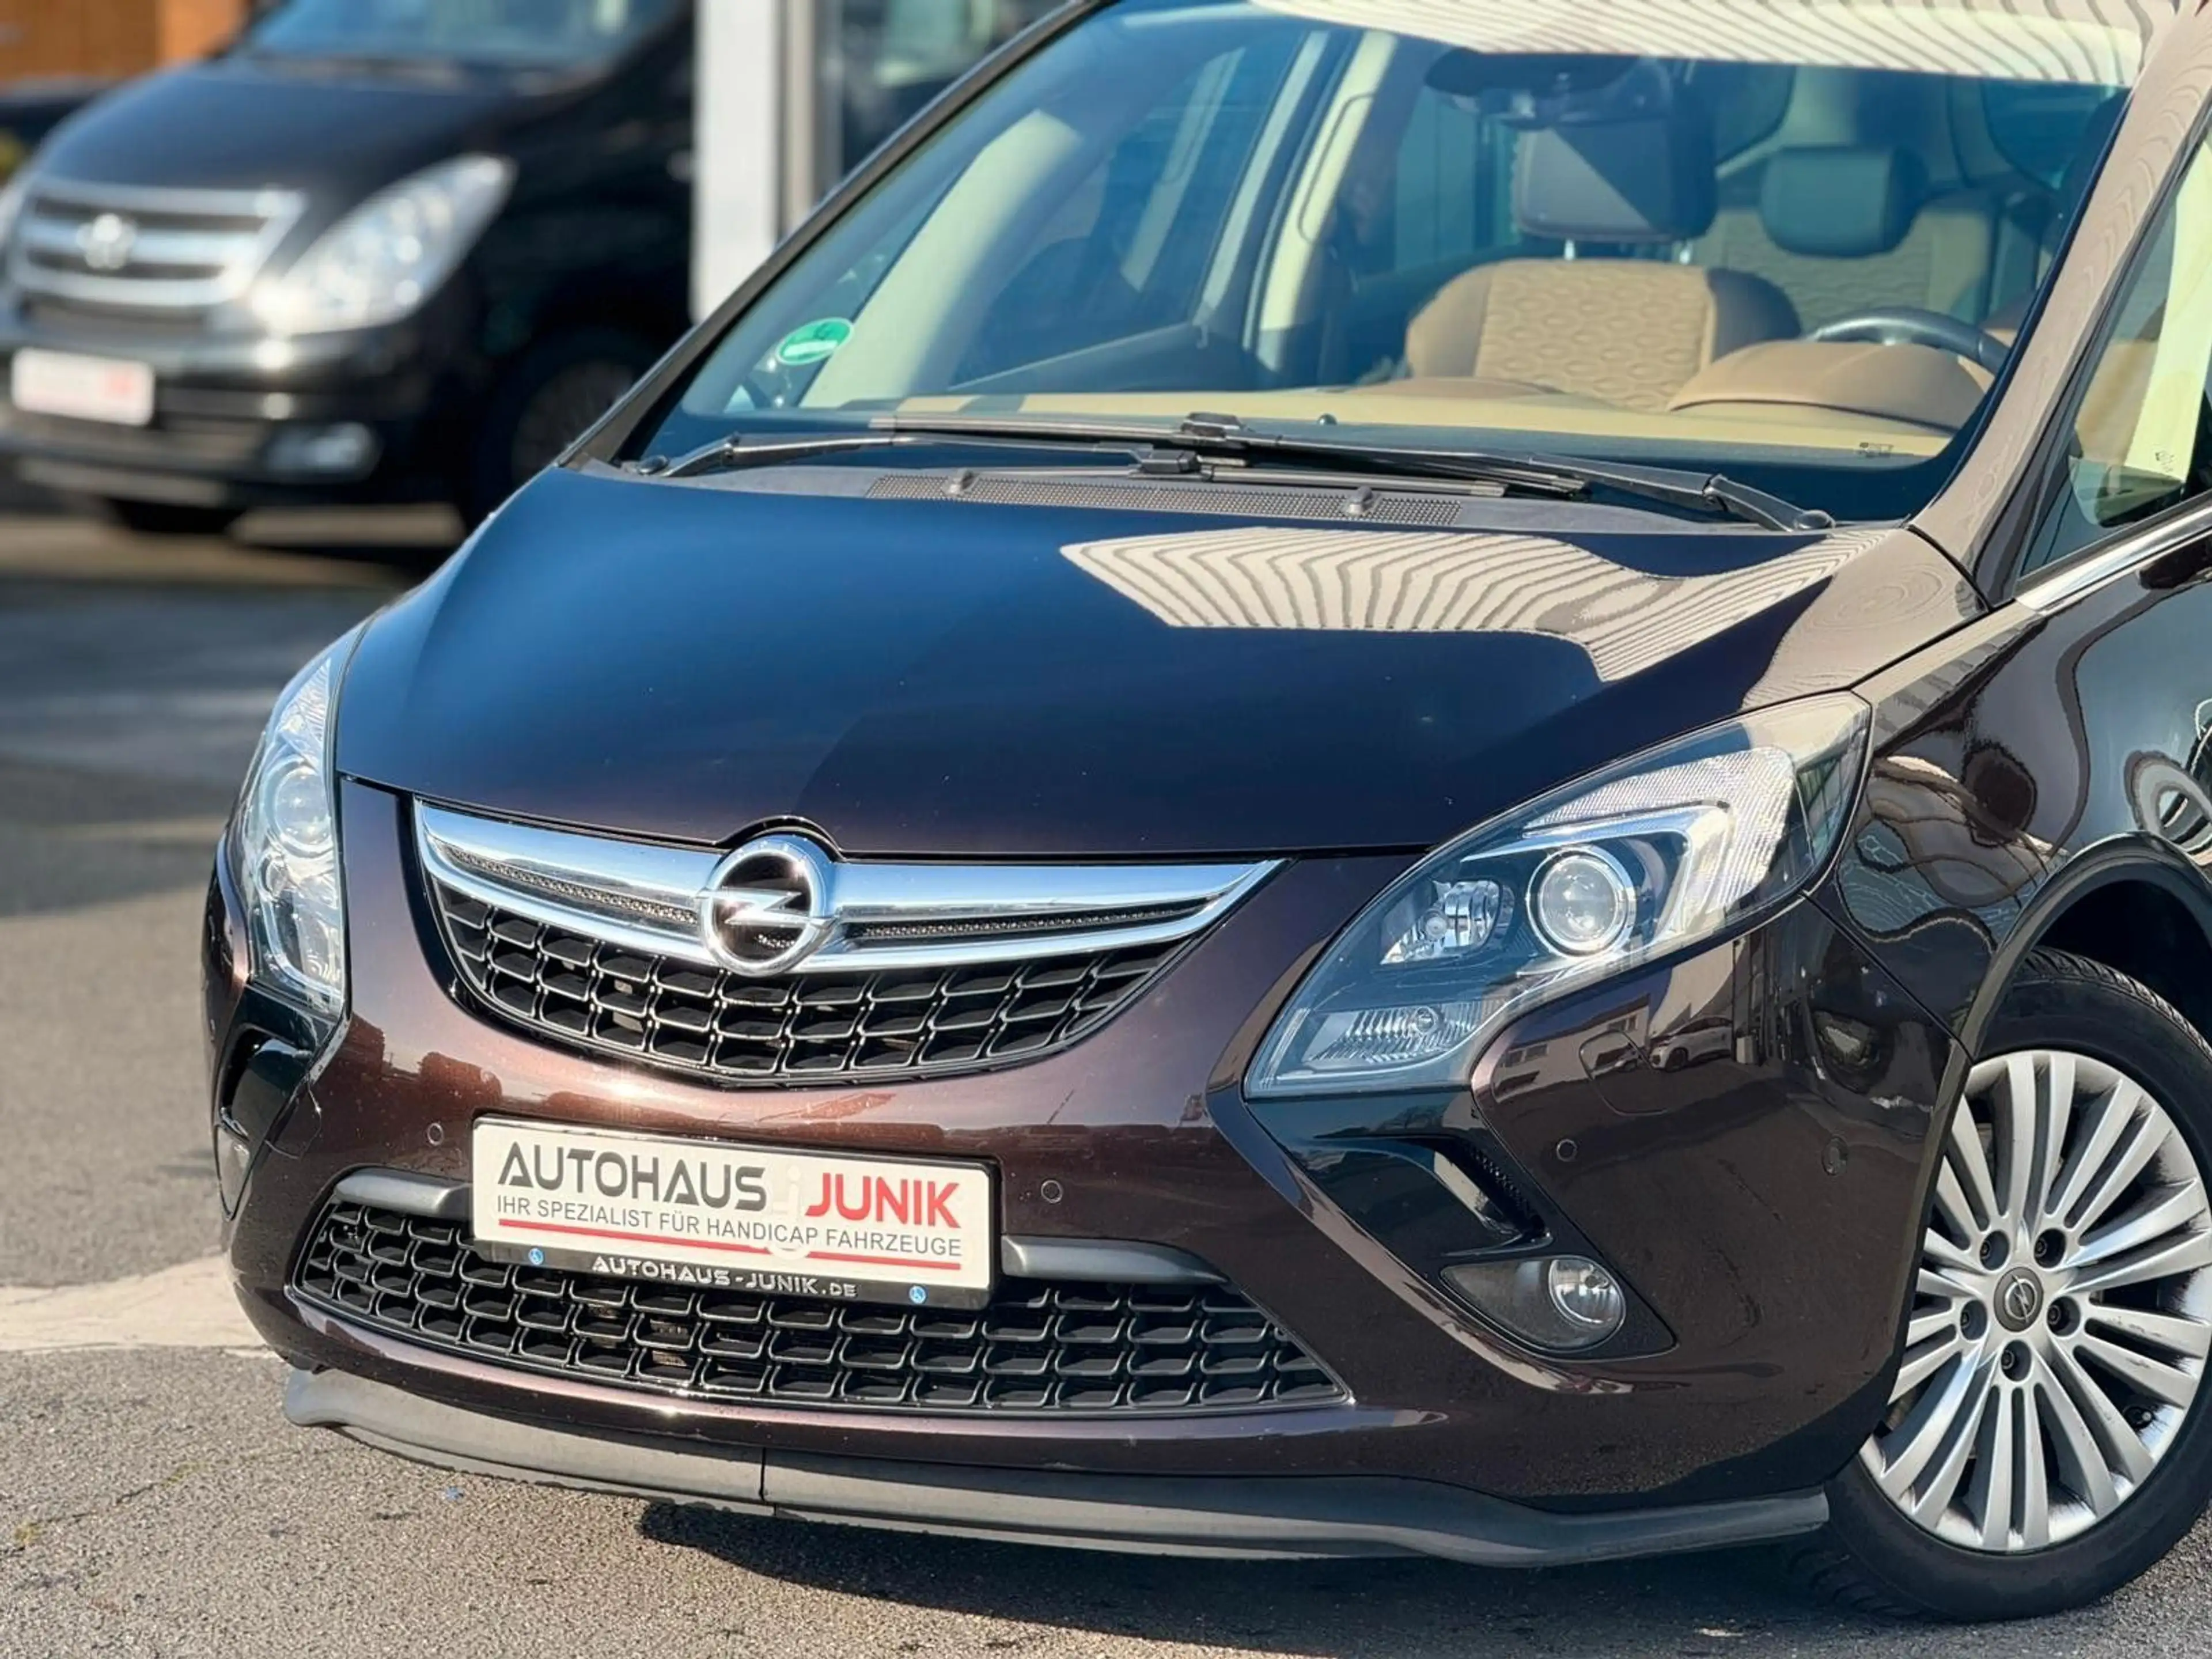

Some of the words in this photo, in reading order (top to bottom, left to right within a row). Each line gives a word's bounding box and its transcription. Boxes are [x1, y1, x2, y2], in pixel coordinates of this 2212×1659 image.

[498, 1141, 767, 1212] AUTOHAUS
[804, 1172, 961, 1229] JUNIK
[497, 1195, 531, 1215] IHR
[537, 1199, 653, 1228] SPEZIALIST
[660, 1209, 700, 1234] FÜR
[707, 1218, 818, 1245] HANDICAP
[825, 1228, 963, 1257] FAHRZEUGE
